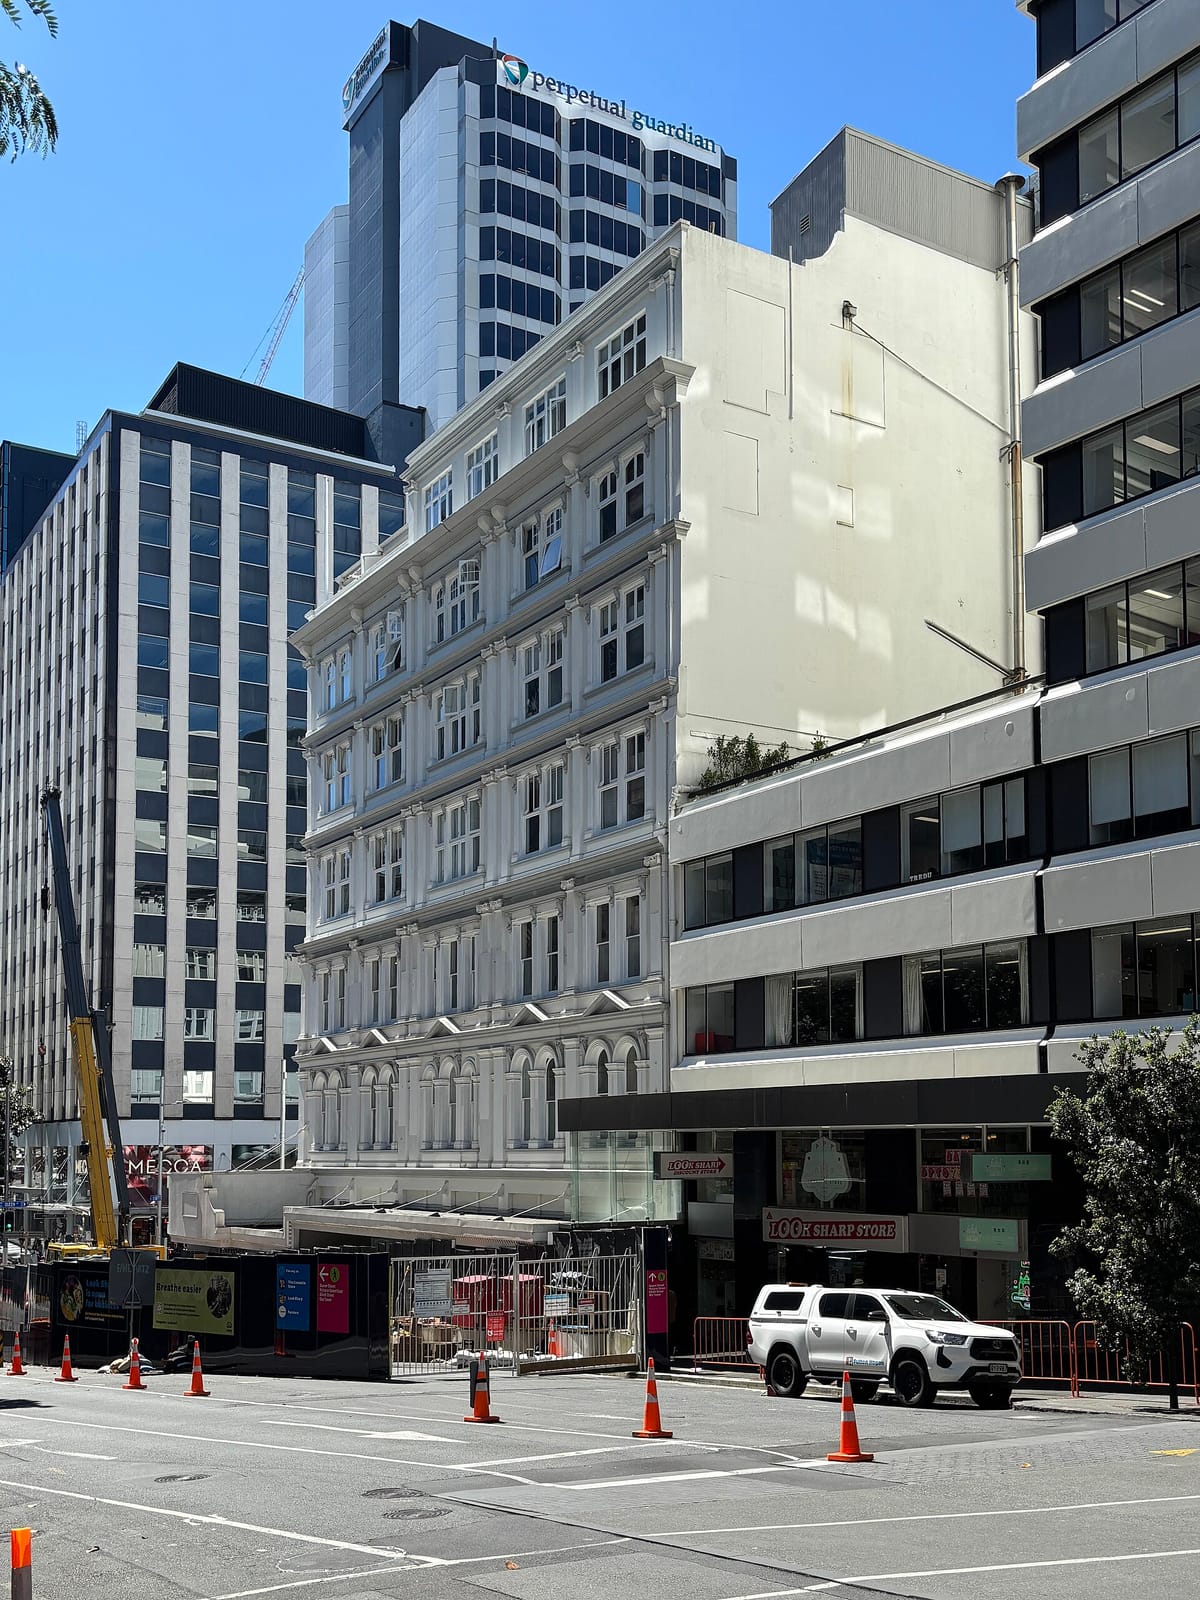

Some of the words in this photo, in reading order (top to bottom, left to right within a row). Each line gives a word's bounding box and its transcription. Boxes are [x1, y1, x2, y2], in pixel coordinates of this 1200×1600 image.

[531, 71, 626, 119] perpetual
[631, 110, 717, 153] guardian
[128, 1159, 202, 1176] MECCA
[668, 1160, 694, 1170] LOOK
[695, 1160, 722, 1169] SHARP
[769, 1219, 811, 1239] LOOK
[813, 1223, 855, 1237] SHARP
[856, 1223, 895, 1238] STORE
[156, 1282, 181, 1293] Breathe
[182, 1285, 202, 1294] easier
